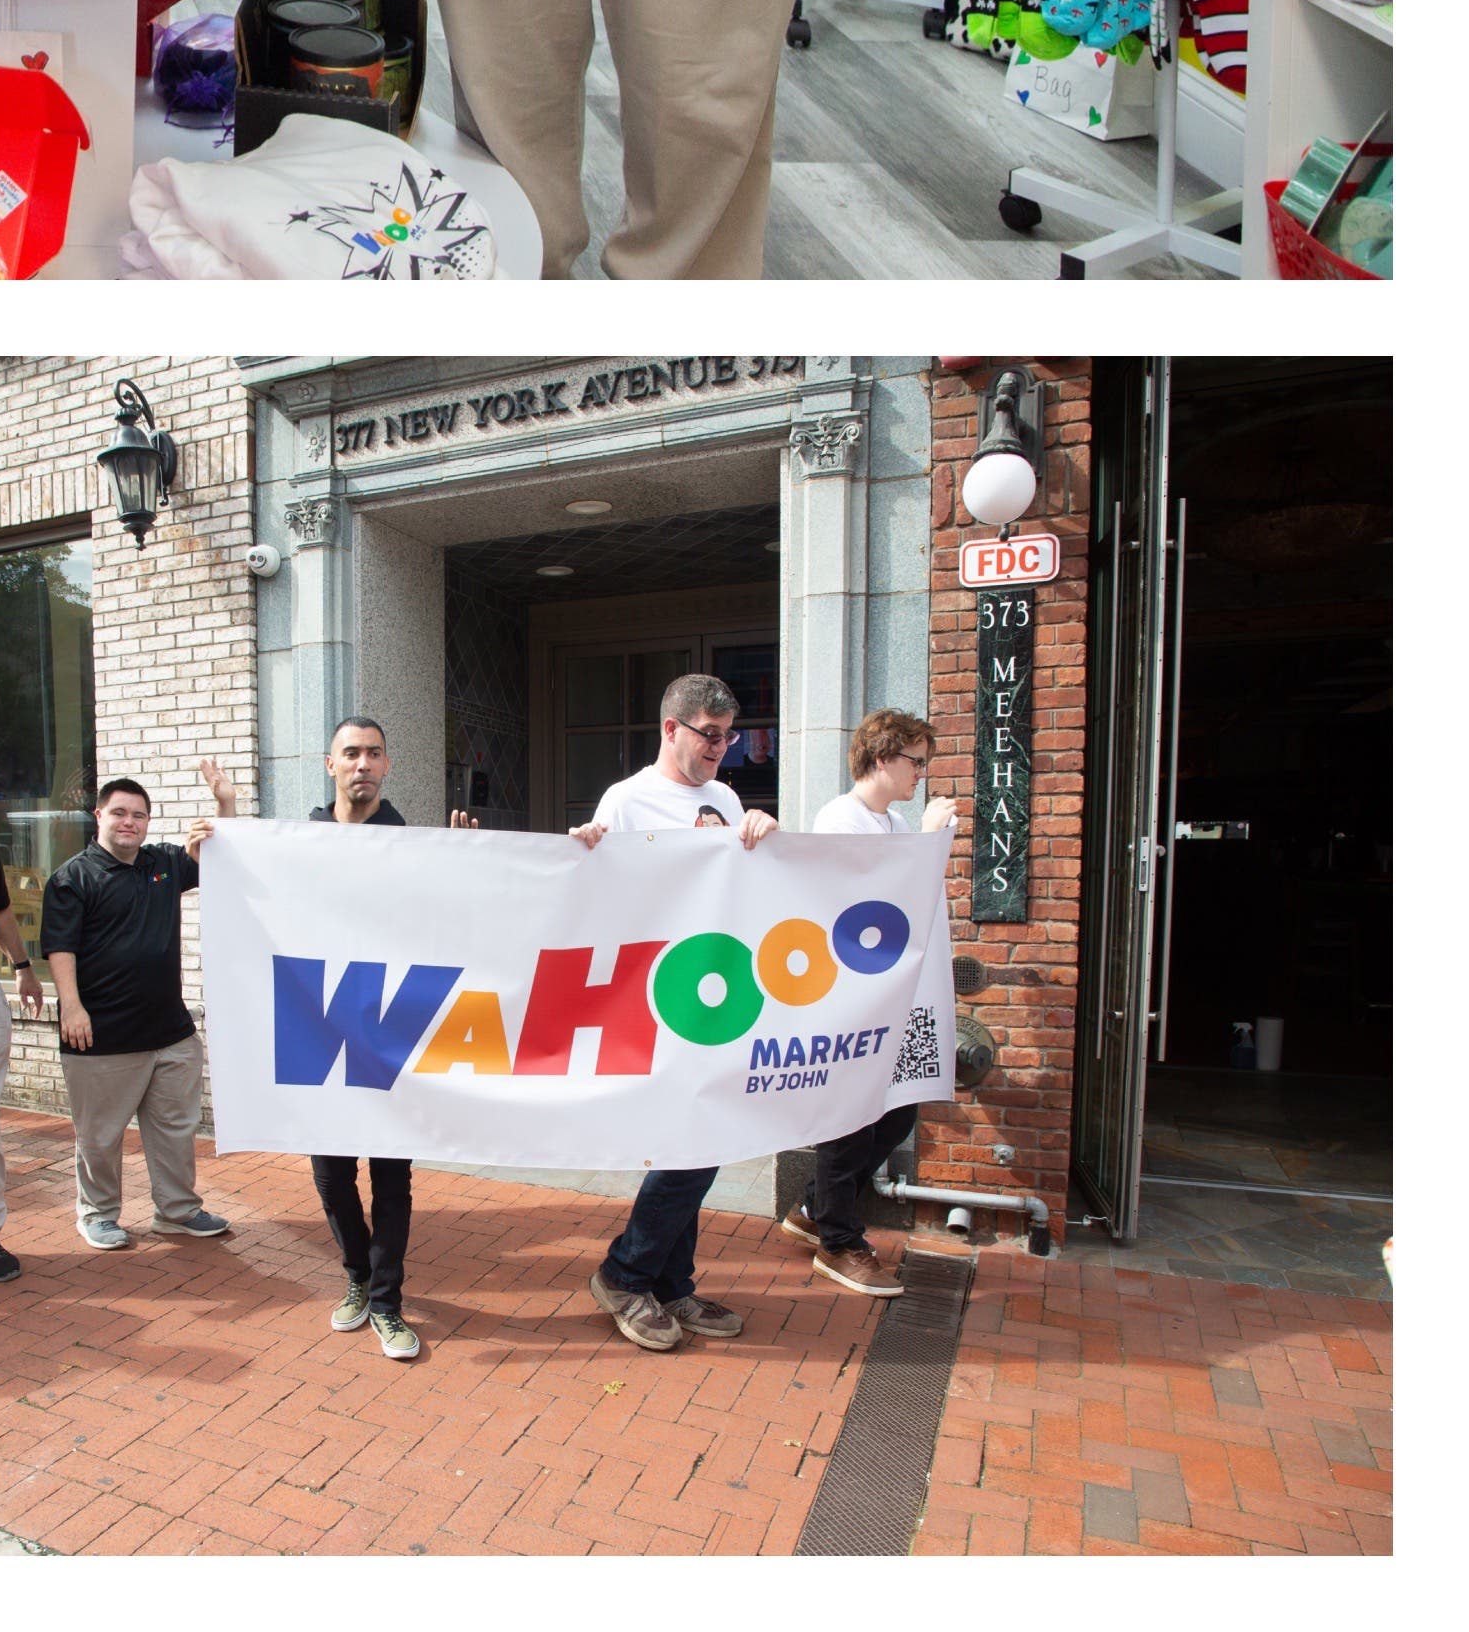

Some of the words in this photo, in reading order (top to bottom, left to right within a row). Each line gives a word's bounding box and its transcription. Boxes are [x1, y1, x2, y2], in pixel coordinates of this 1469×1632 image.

[1035, 65, 1073, 113] Bag
[336, 420, 376, 456] 377
[383, 403, 461, 446] NEW
[468, 381, 570, 429] YORK
[577, 356, 739, 409] AVENUE
[977, 544, 1040, 577] FDC
[982, 600, 1030, 629] 373
[990, 656, 1017, 893] MEEHANS
[272, 899, 911, 1092] WAHOOO
[748, 1025, 891, 1071] MARKET
[745, 1075, 774, 1094] BY
[776, 1068, 828, 1093] JOHN
